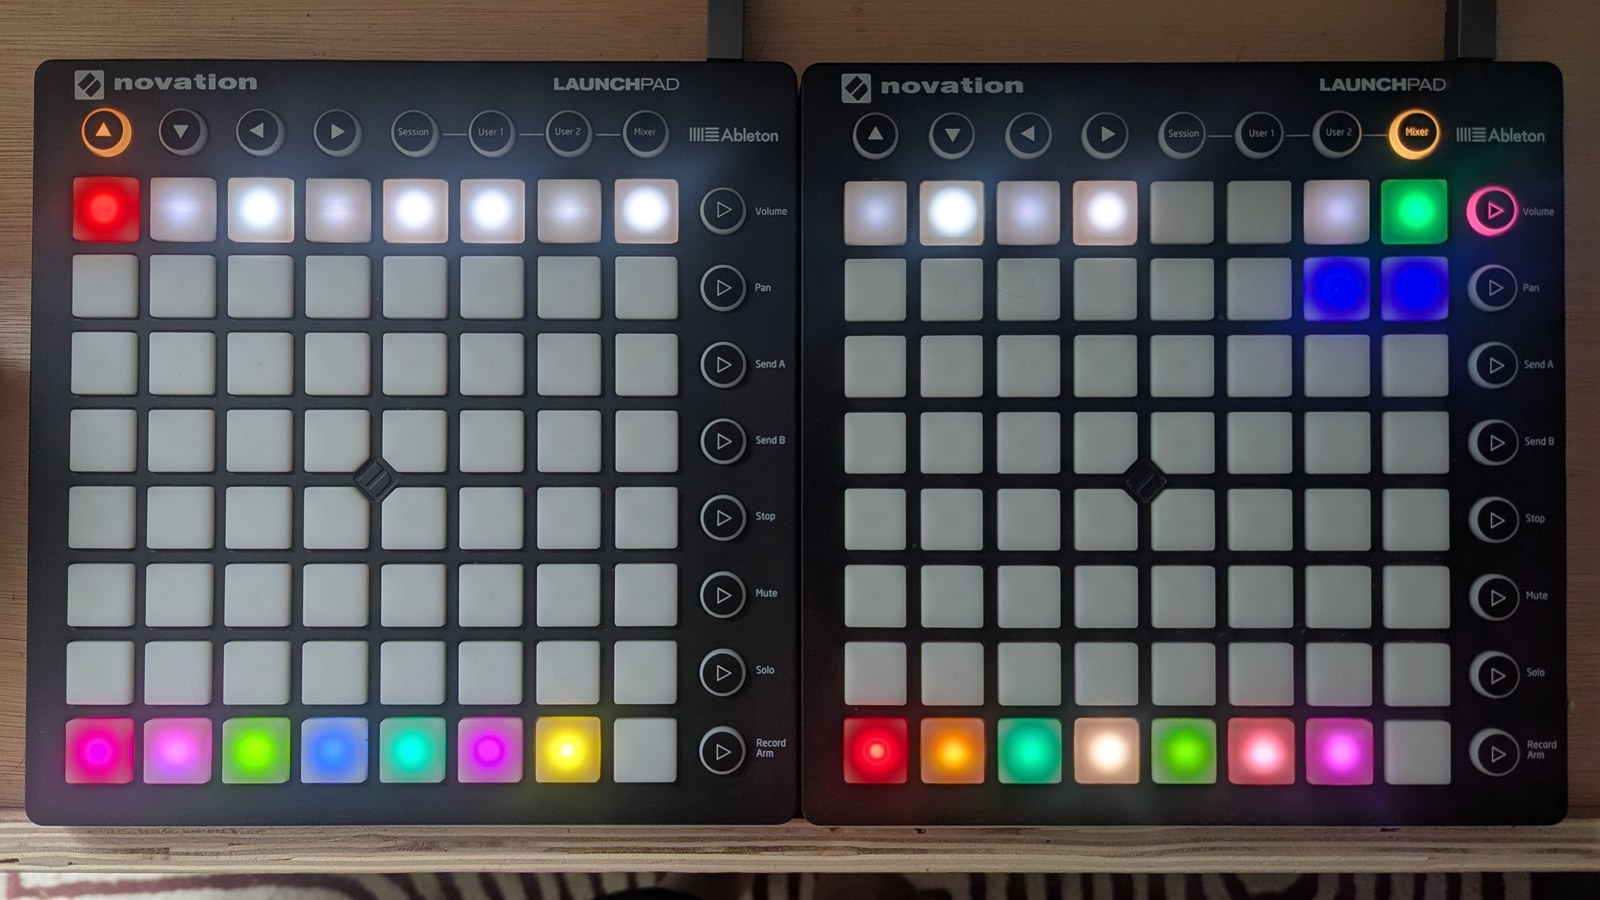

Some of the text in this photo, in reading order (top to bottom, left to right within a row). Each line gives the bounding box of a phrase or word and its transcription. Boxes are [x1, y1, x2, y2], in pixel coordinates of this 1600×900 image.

[115, 73, 257, 90] novation
[554, 77, 679, 91] LAUNCHPAD
[882, 77, 1023, 93] novation
[1320, 78, 1447, 91] LAUNCHPAD
[398, 128, 429, 137] Session
[479, 128, 504, 136] User 1
[555, 128, 582, 136] User 2
[634, 128, 657, 136] Mixer
[721, 128, 779, 143] Ableton
[1168, 129, 1199, 138] Session
[1249, 129, 1275, 138] User 1
[1326, 128, 1353, 137] User 2
[1405, 127, 1428, 136] Mixer
[1488, 128, 1546, 143] Ableton
[755, 207, 787, 215] Volume
[1523, 208, 1554, 216] Volume
[755, 283, 771, 291] Pan
[1523, 284, 1539, 292] Pan
[756, 360, 785, 369] Send A
[1524, 360, 1554, 369] Send A
[756, 436, 785, 445] Send B
[1525, 437, 1554, 446] Send B
[756, 512, 775, 521] Stop
[1526, 514, 1545, 524] Stop
[756, 589, 777, 597] Mute
[1526, 591, 1548, 600] Mute
[756, 666, 774, 674] Solo
[1527, 668, 1545, 676] Solo
[757, 739, 786, 747] Record
[1527, 740, 1557, 749] Record
[756, 749, 773, 757] Arm
[1527, 750, 1544, 759] Arm
